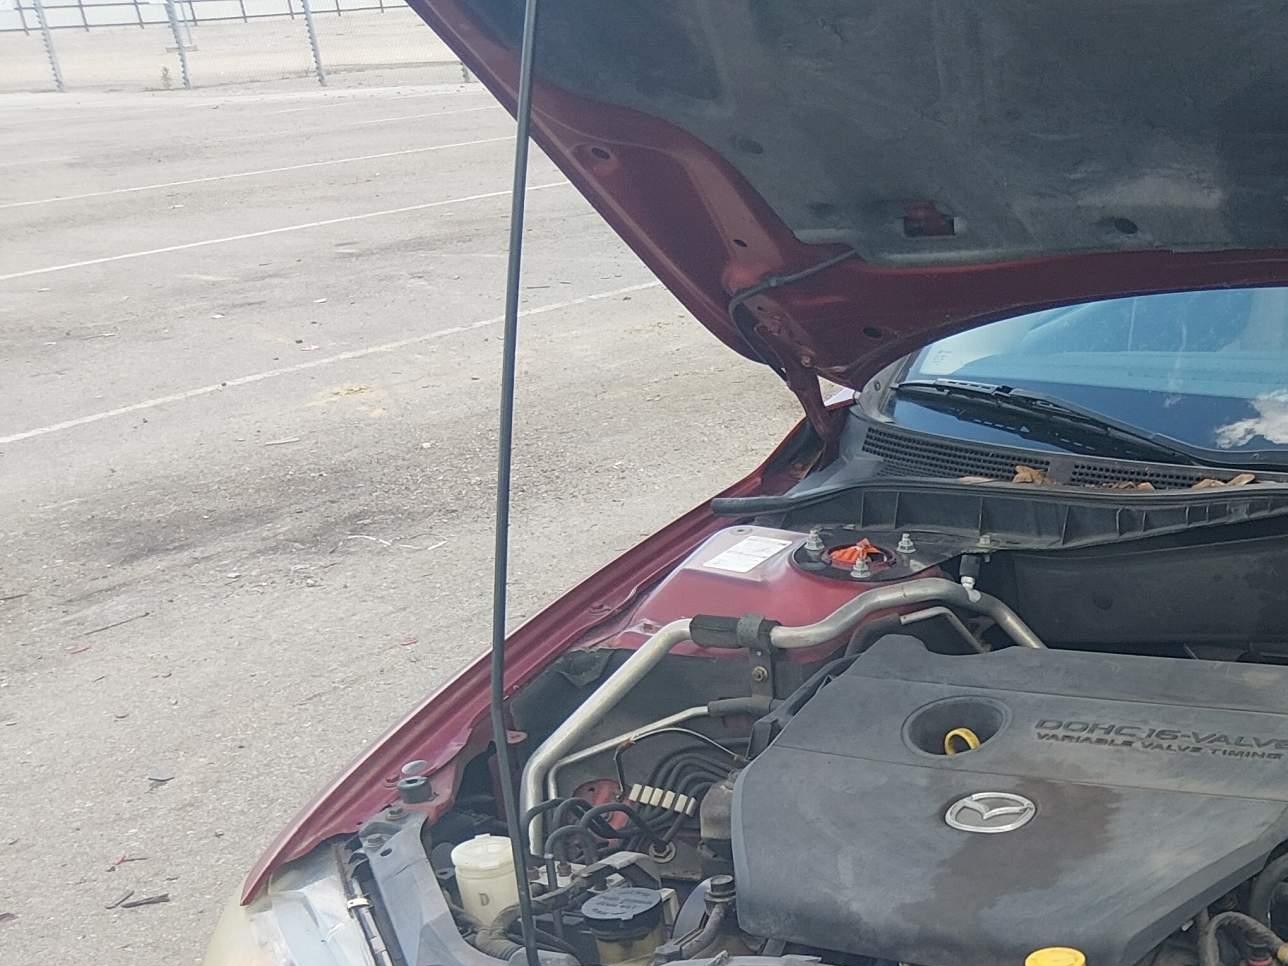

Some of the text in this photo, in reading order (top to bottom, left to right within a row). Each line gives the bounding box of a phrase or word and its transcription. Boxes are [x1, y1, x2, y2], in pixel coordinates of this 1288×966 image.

[1035, 719, 1145, 738] DOHC
[1036, 733, 1285, 760] VARIABLE VALVE TIMING
